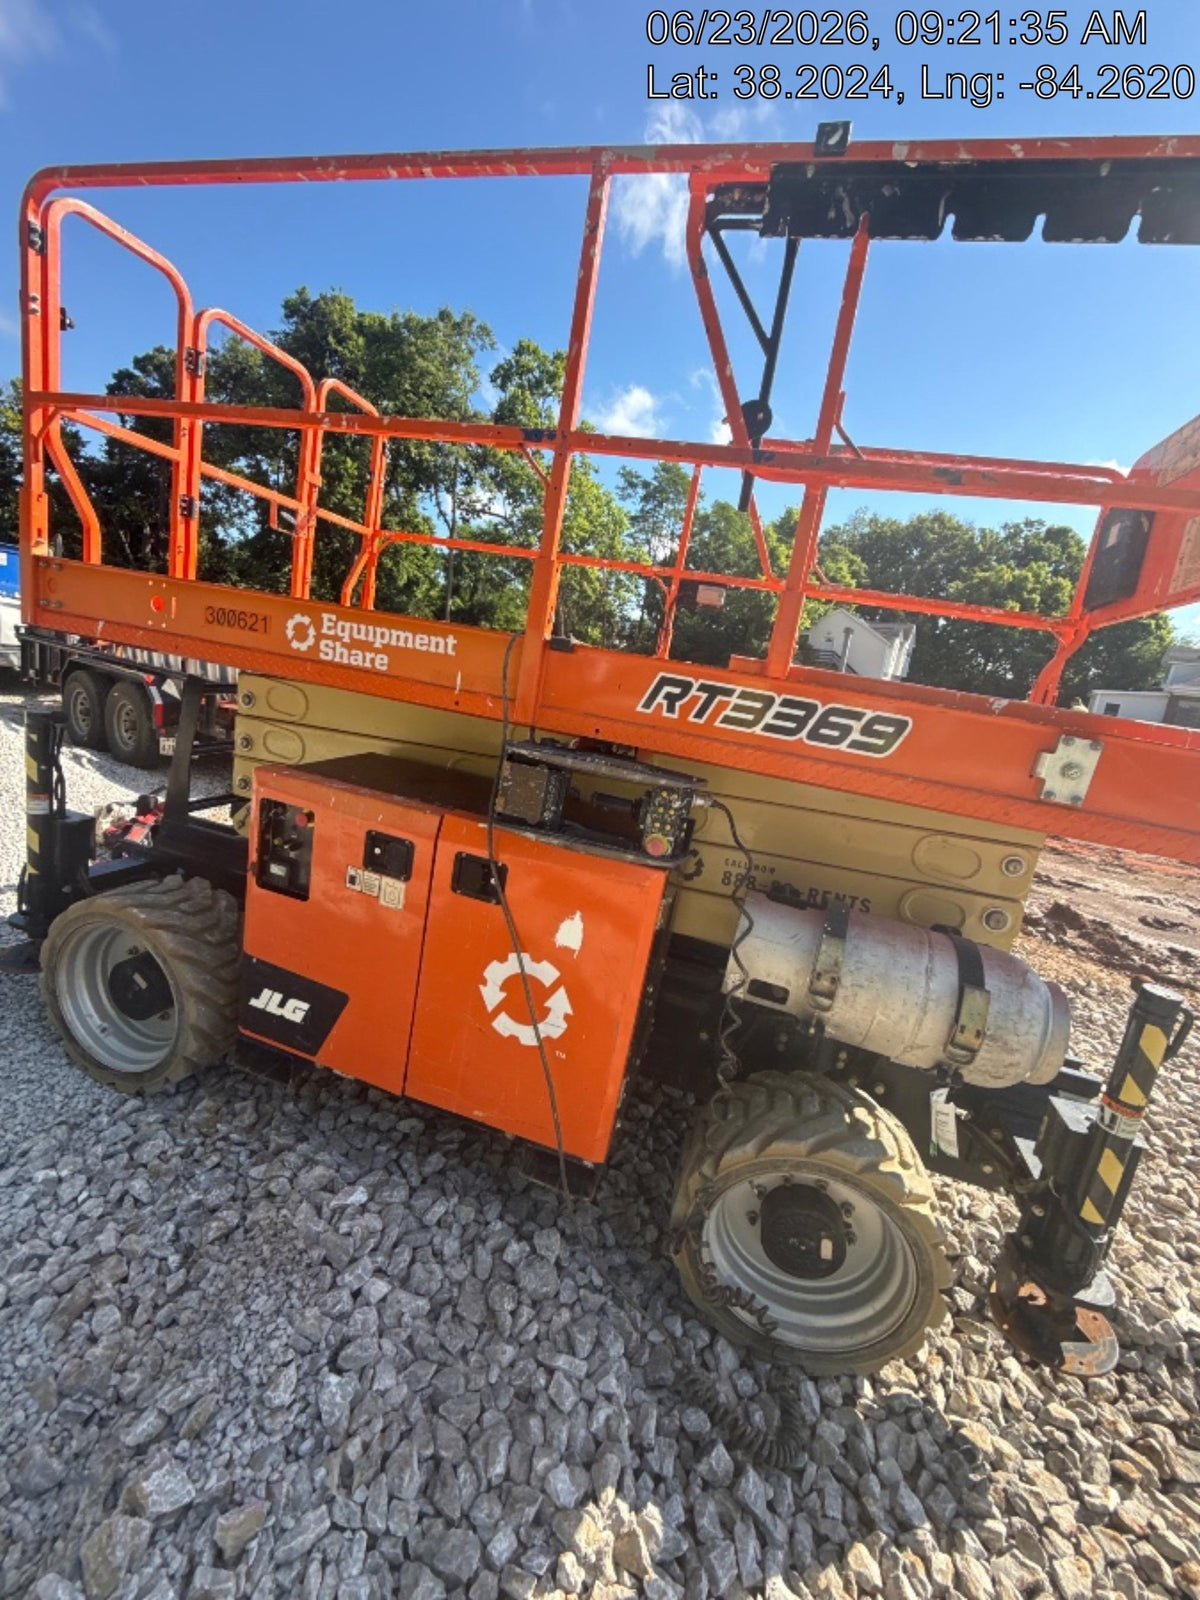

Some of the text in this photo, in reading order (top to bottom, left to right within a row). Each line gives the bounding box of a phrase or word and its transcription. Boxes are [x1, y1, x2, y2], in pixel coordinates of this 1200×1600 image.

[205, 605, 268, 634] 300621
[321, 613, 457, 656] Equipment
[319, 639, 389, 671] Share
[635, 671, 913, 758] RT3369
[248, 988, 311, 1024] JLG
